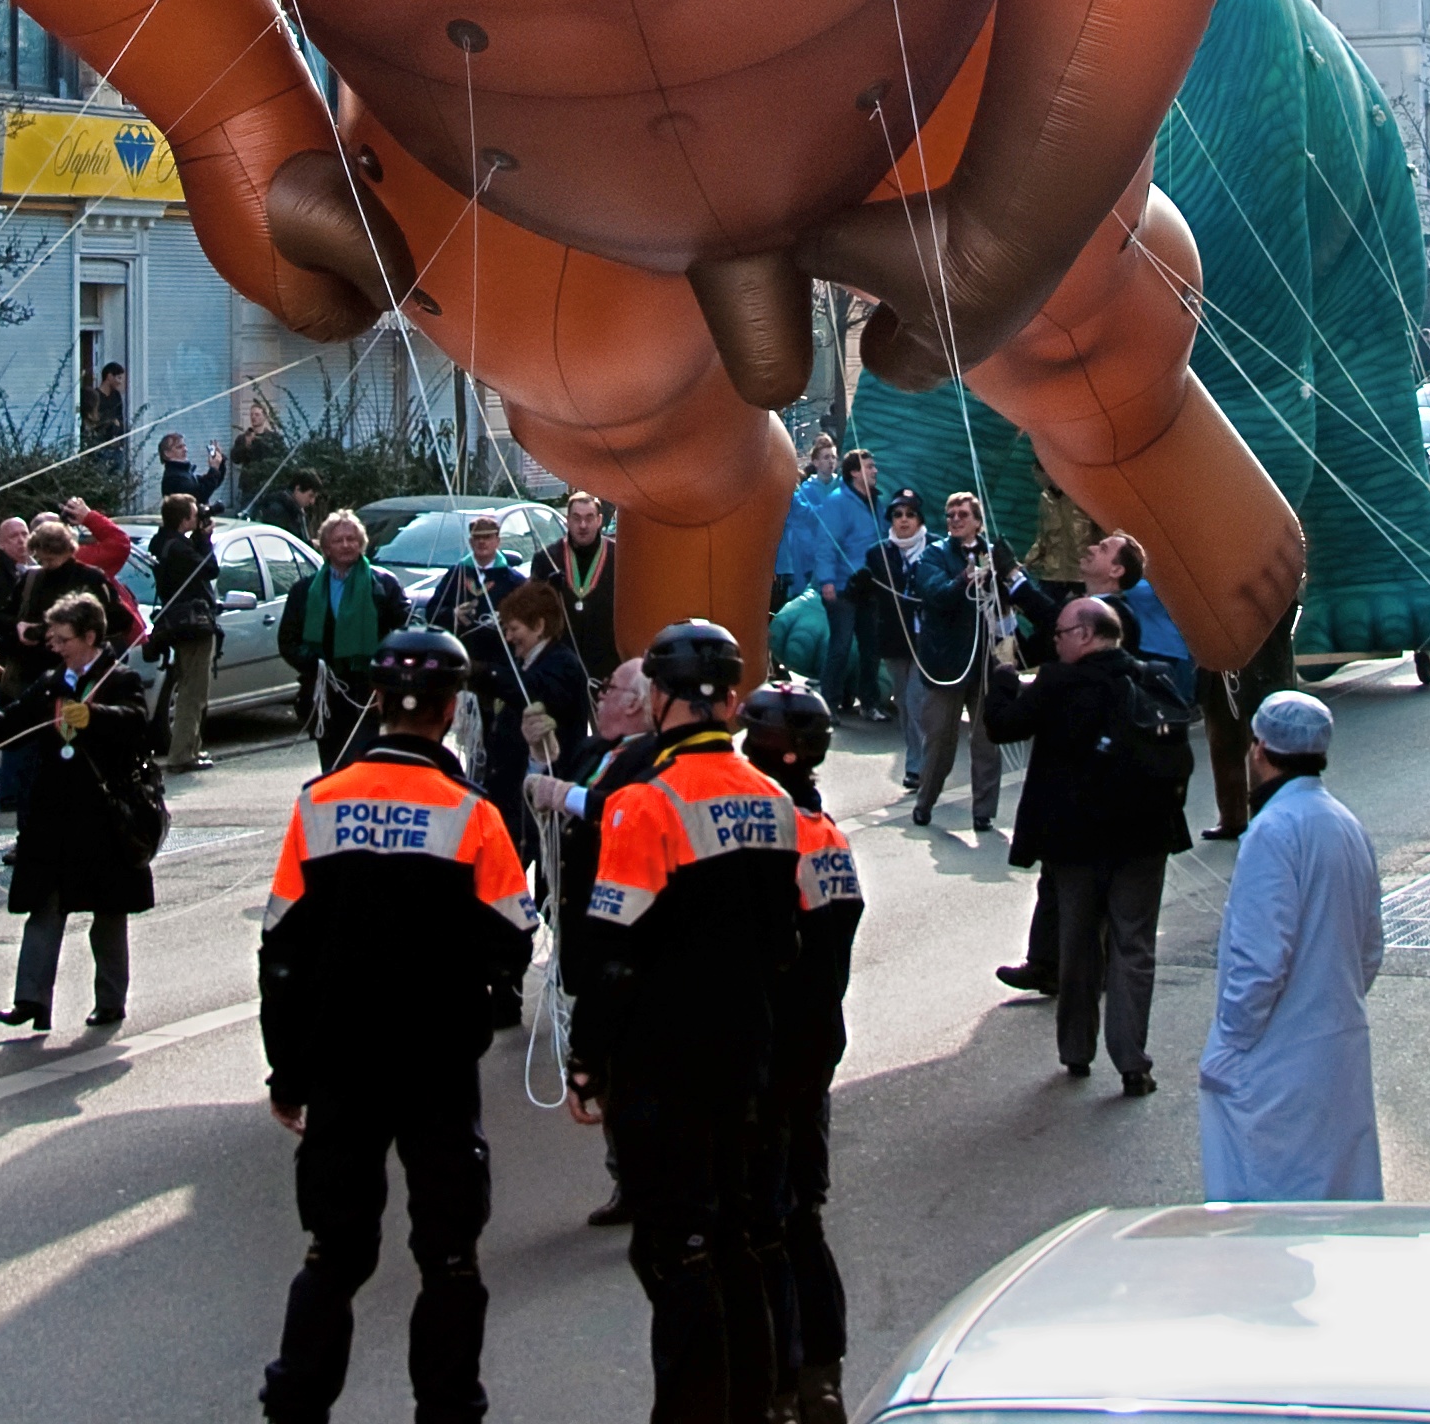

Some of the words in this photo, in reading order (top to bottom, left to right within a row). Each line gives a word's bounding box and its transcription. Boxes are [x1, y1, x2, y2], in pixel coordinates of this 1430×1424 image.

[54, 129, 113, 190] Saphir
[336, 803, 430, 827] POLICE
[336, 826, 427, 848] POLITIE
